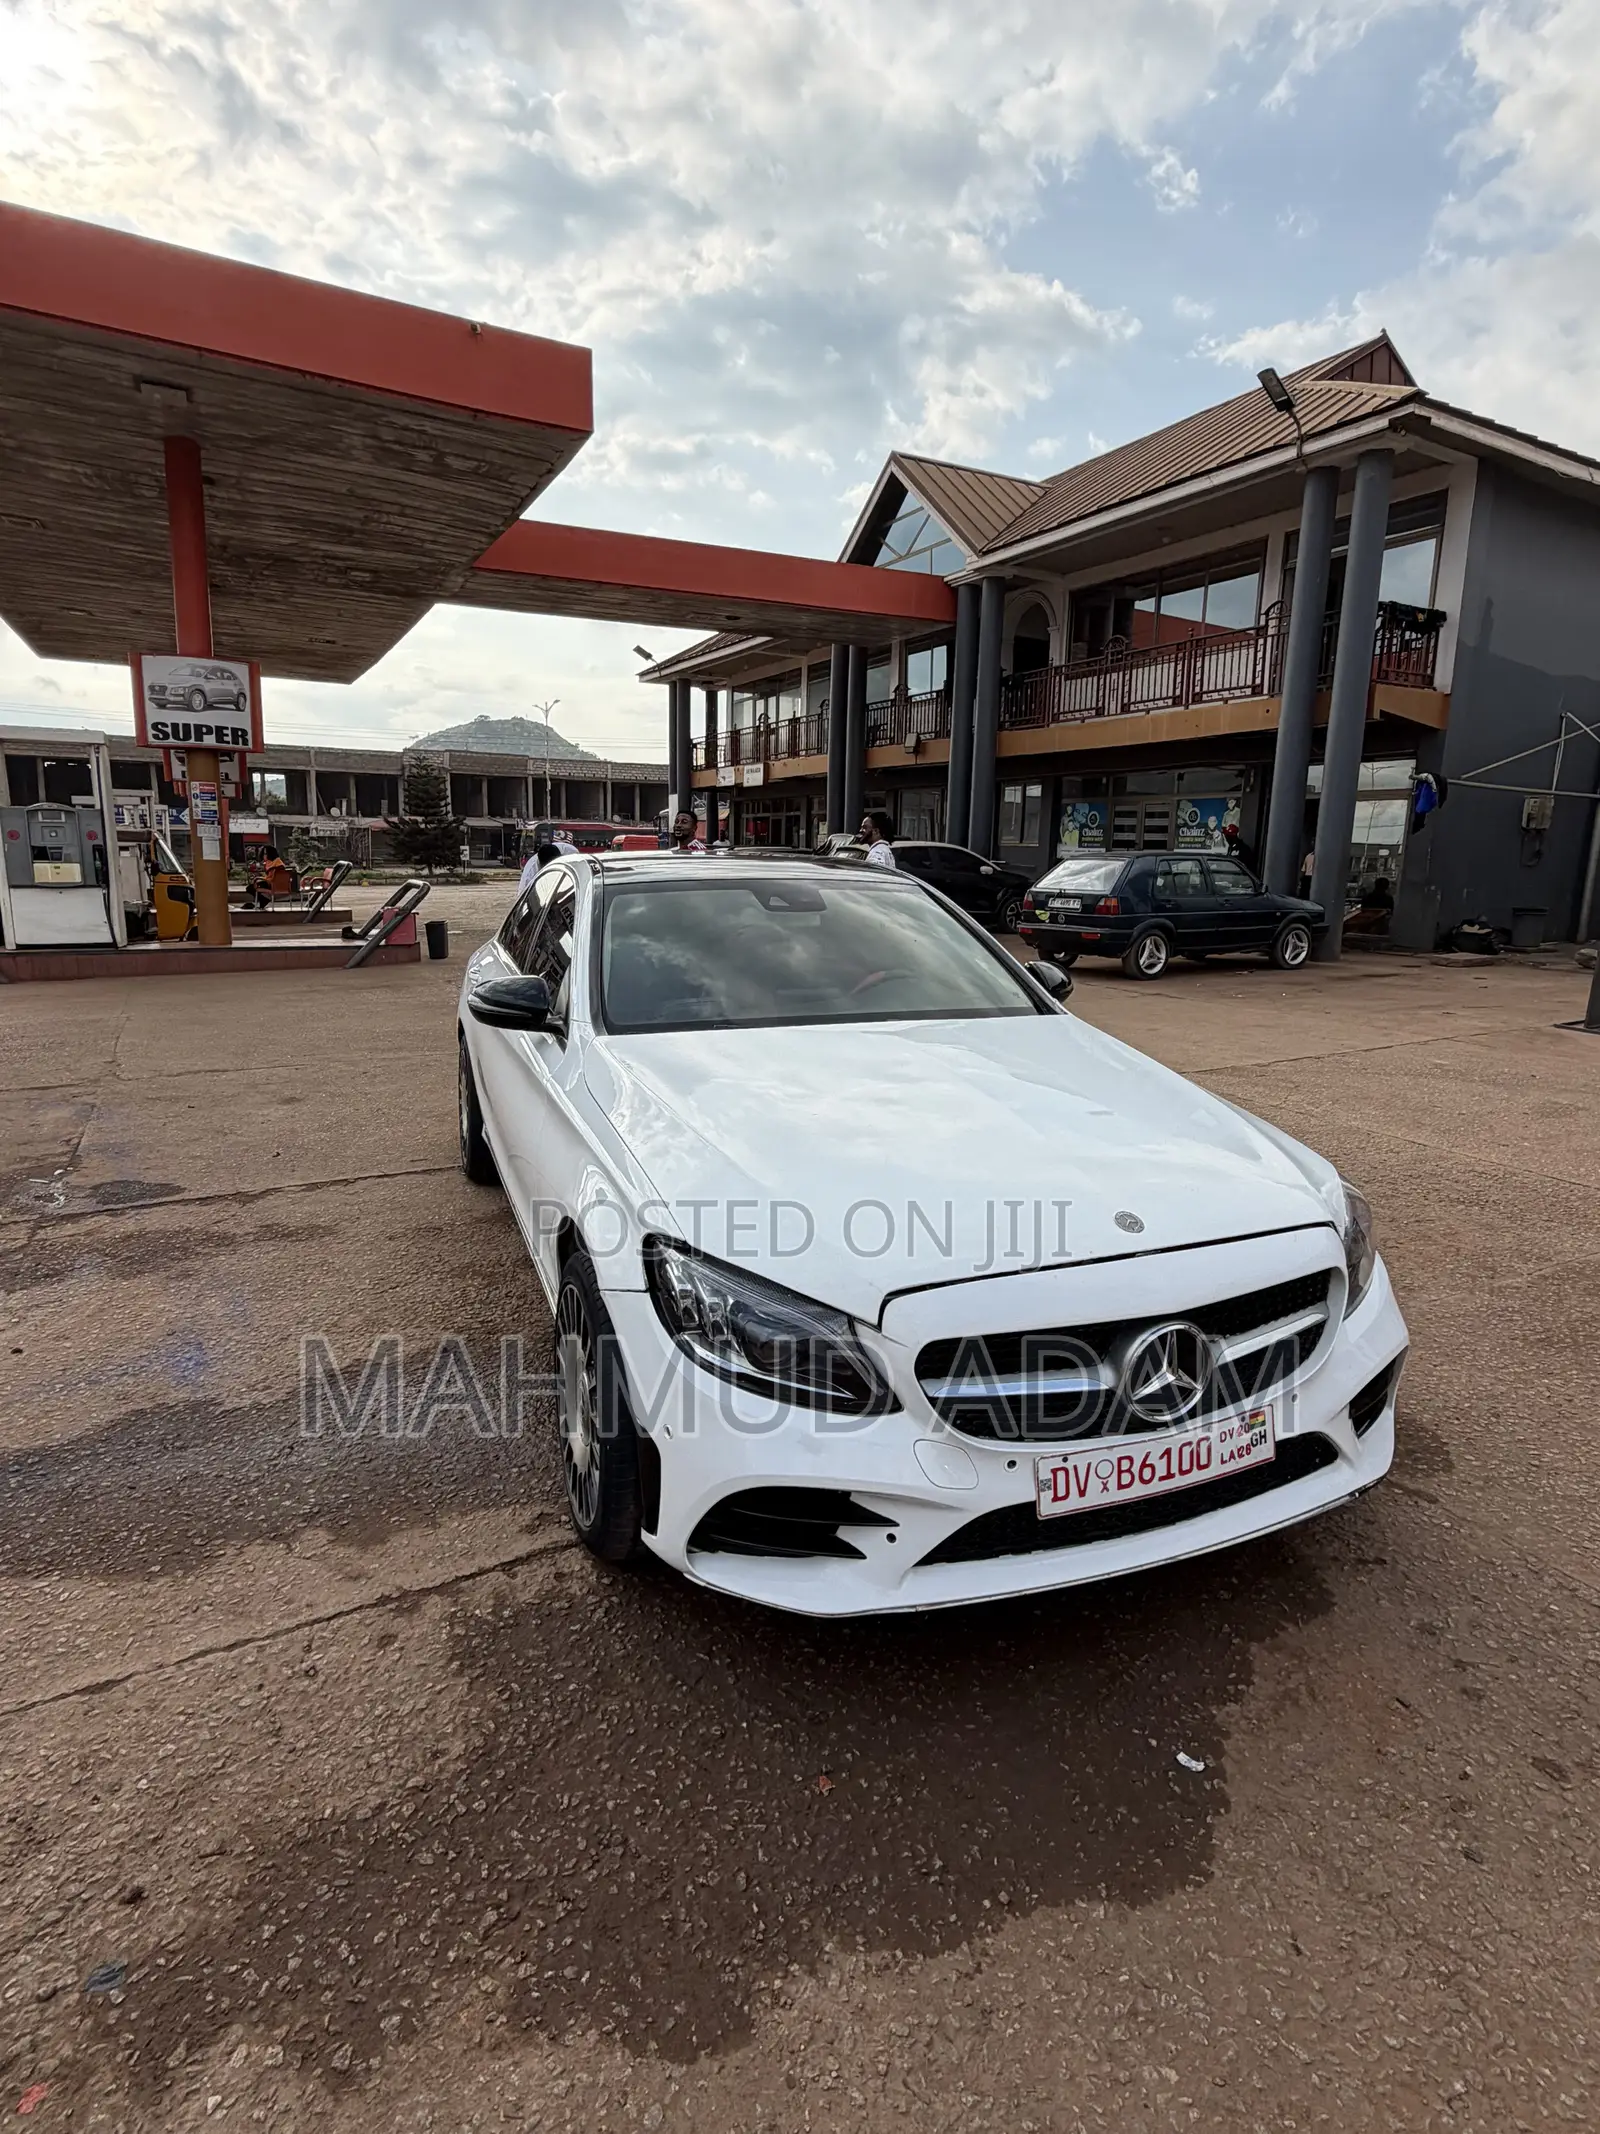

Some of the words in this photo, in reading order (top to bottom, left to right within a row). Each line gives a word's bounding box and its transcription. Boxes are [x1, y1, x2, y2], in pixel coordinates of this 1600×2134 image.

[151, 721, 249, 746] SUPER
[1220, 1426, 1235, 1443] DV
[1250, 1428, 1268, 1448] GH
[1116, 1435, 1213, 1491] B6100
